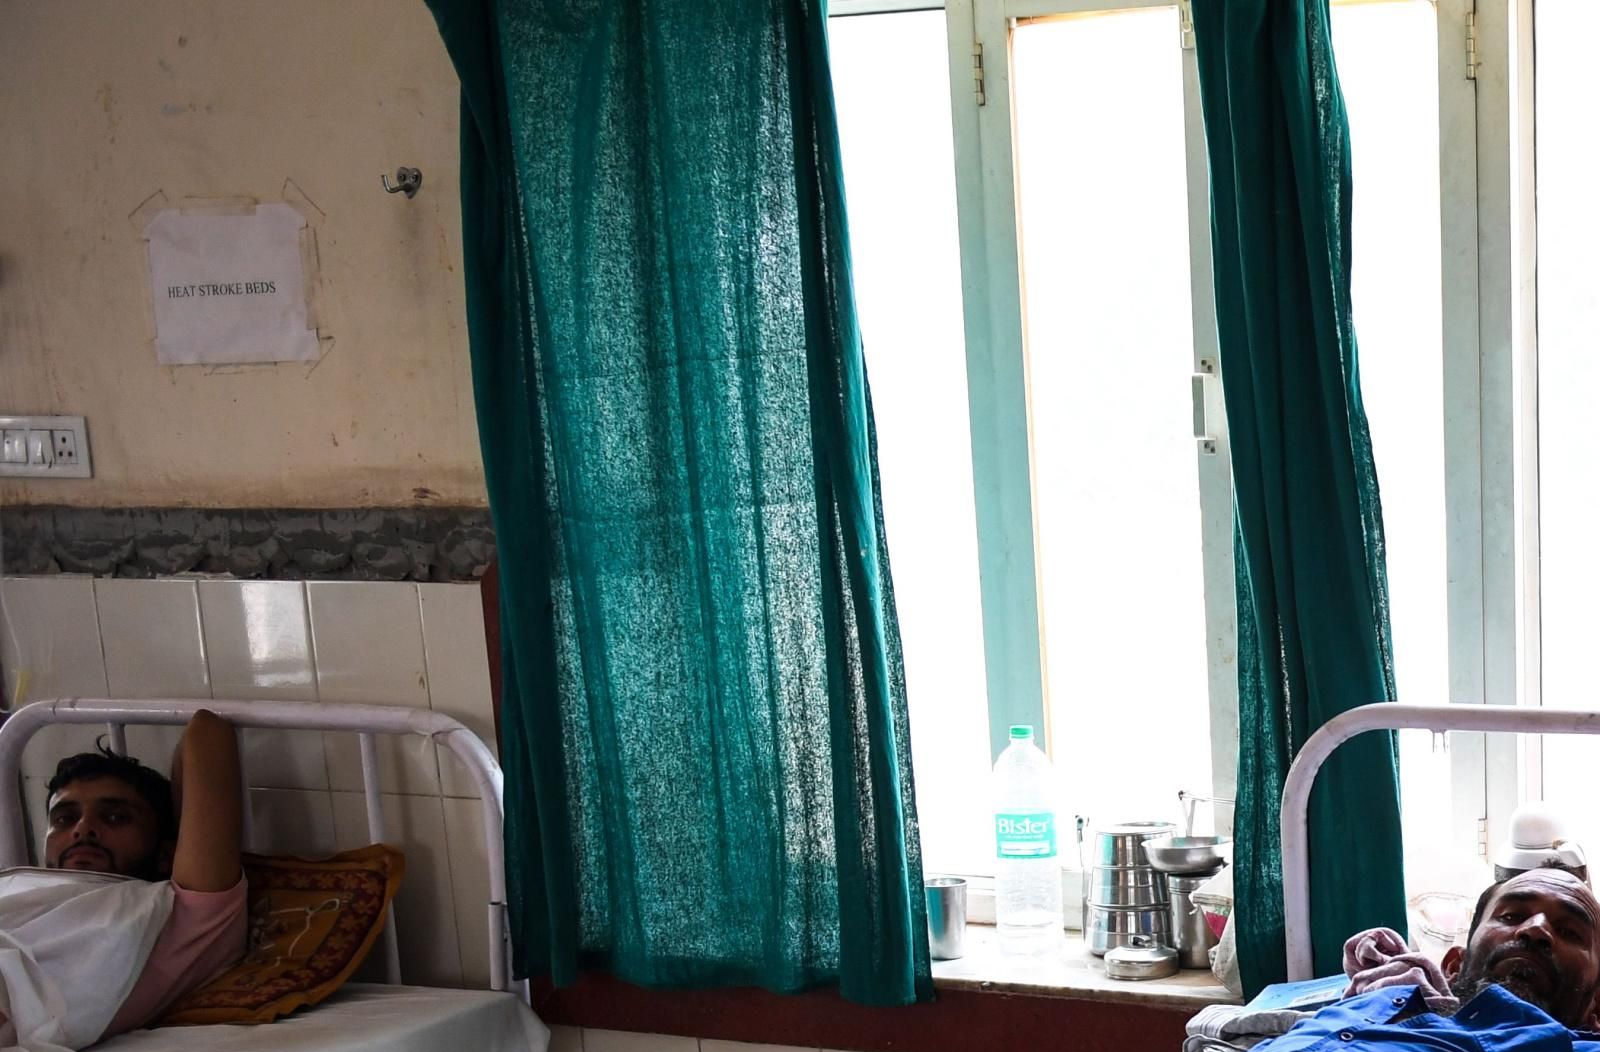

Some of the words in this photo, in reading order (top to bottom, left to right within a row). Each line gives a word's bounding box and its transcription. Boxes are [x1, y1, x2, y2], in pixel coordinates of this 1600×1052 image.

[167, 286, 196, 299] HEAT
[198, 283, 243, 297] STROKE
[245, 281, 277, 295] BEDS
